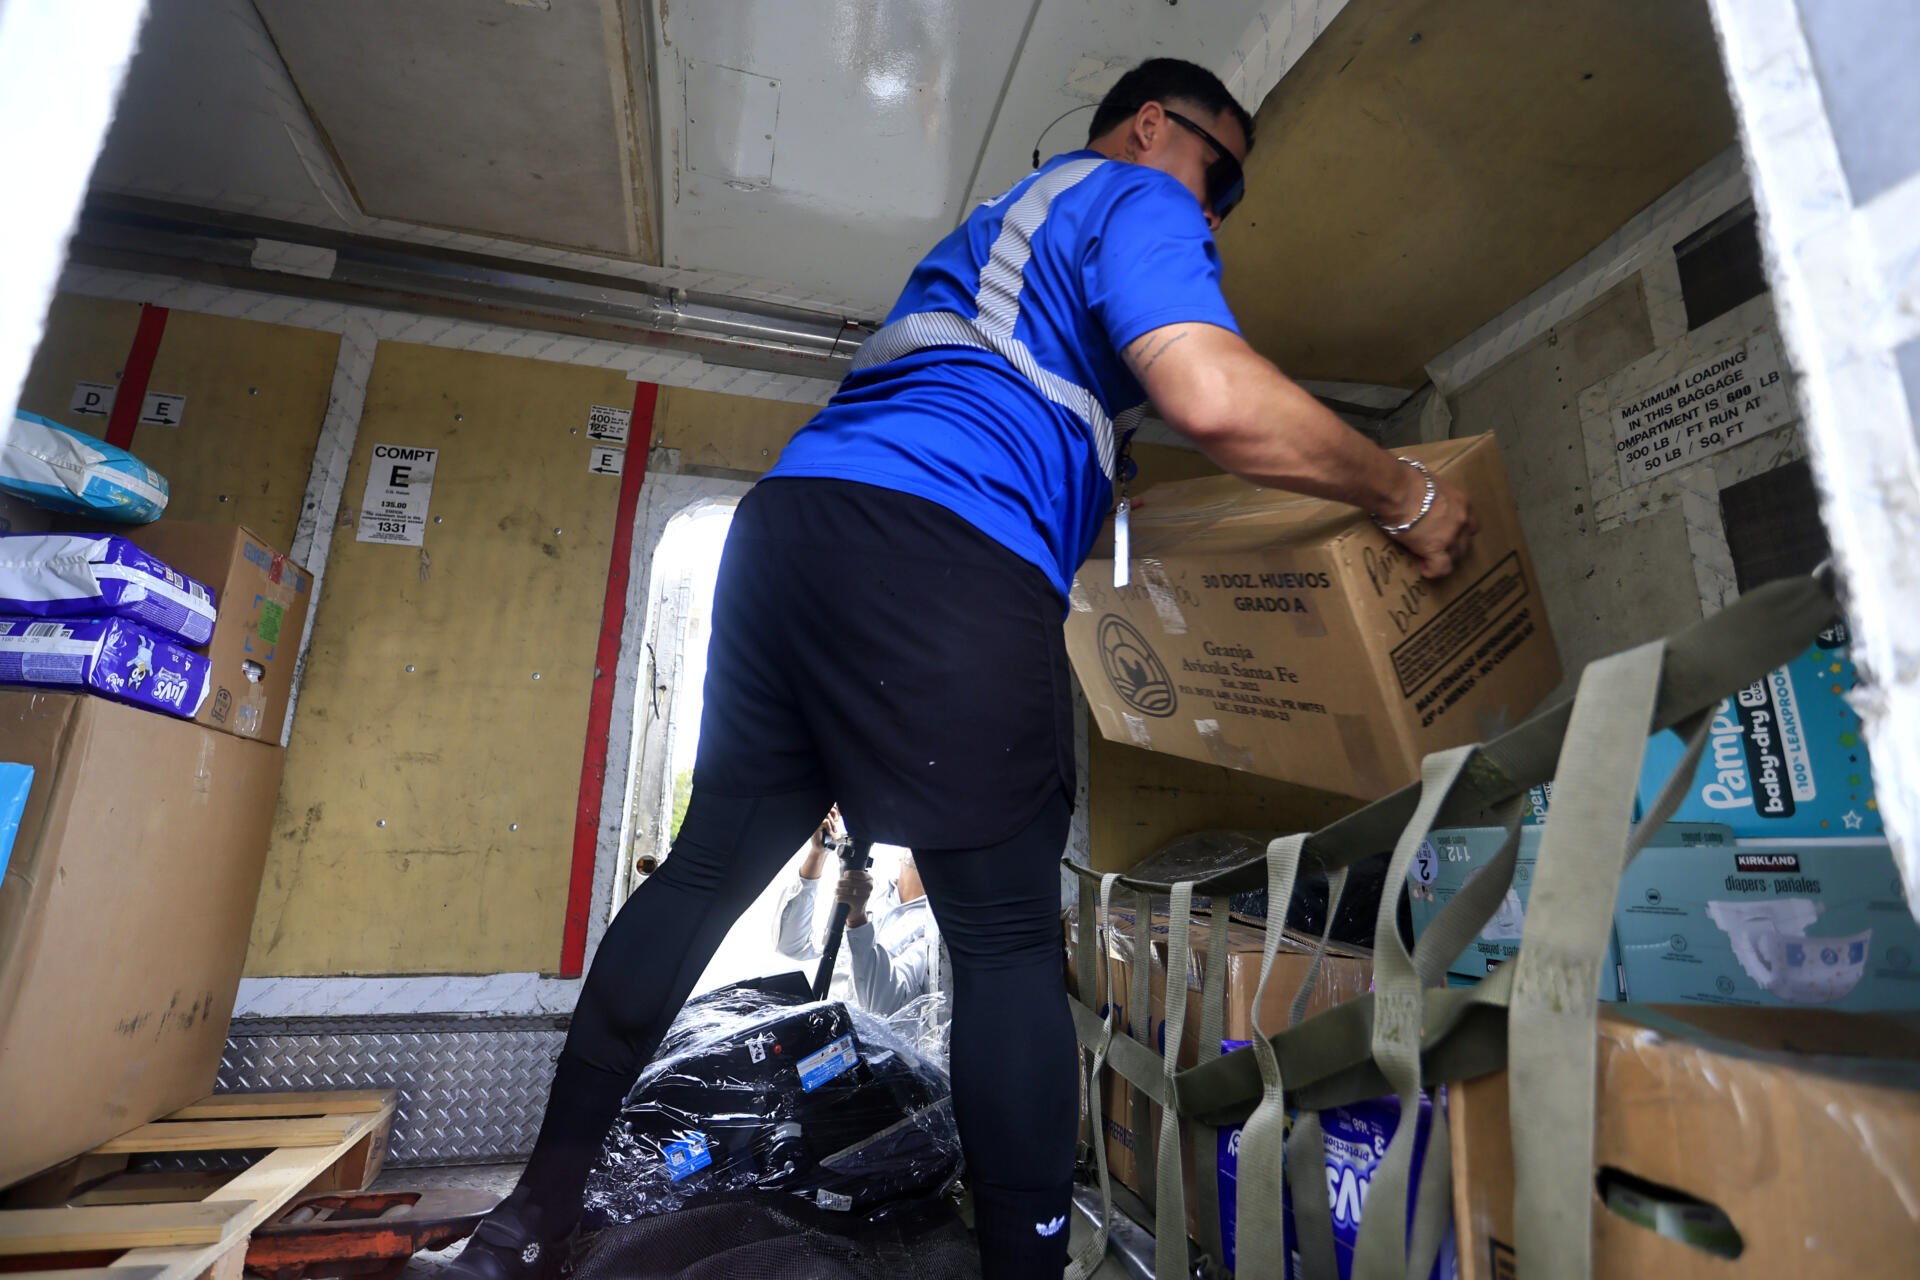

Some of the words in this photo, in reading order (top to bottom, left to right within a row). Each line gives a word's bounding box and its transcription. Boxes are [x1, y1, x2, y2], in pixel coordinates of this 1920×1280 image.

[1621, 383, 1681, 419] MAXIMUM
[1685, 351, 1747, 389] LOADING
[1705, 398, 1719, 412] IS
[1726, 385, 1752, 403] 600
[1759, 371, 1780, 388] LB
[85, 392, 100, 406] D
[1628, 418, 1641, 431] IN
[1645, 404, 1673, 426] THIS
[1680, 369, 1745, 409] BAGGAGE
[156, 402, 171, 416] E
[590, 414, 611, 424] 400
[1626, 446, 1649, 463] 300
[1653, 437, 1670, 452] LB
[1687, 422, 1704, 438] FT
[1709, 407, 1739, 429] RUN
[1745, 397, 1761, 414] AT
[375, 446, 436, 462] COMPT
[1644, 458, 1661, 471] 50
[1665, 448, 1682, 462] LB
[1700, 433, 1721, 449] SQ
[1726, 421, 1745, 438] FT
[601, 454, 613, 467] E
[389, 465, 412, 488] E
[381, 501, 407, 509] 135.00
[377, 522, 407, 533] 1331
[1202, 574, 1220, 589] 30
[1222, 573, 1257, 589] DOZ.
[1261, 572, 1331, 589] HUEVOS
[1234, 597, 1290, 613] GRADO
[1291, 598, 1307, 614] A
[1203, 641, 1256, 662] Granja
[185, 660, 192, 671] 4
[1232, 661, 1275, 682] Santa
[1274, 665, 1299, 684] Fe
[1446, 846, 1471, 862] 112
[1737, 855, 1797, 866] KIRKLAND
[1419, 859, 1431, 881] 2
[1725, 875, 1767, 893] diapers
[1774, 877, 1822, 895] pañales
[1323, 1135, 1371, 1162] protection
[1374, 1136, 1385, 1157] 3
